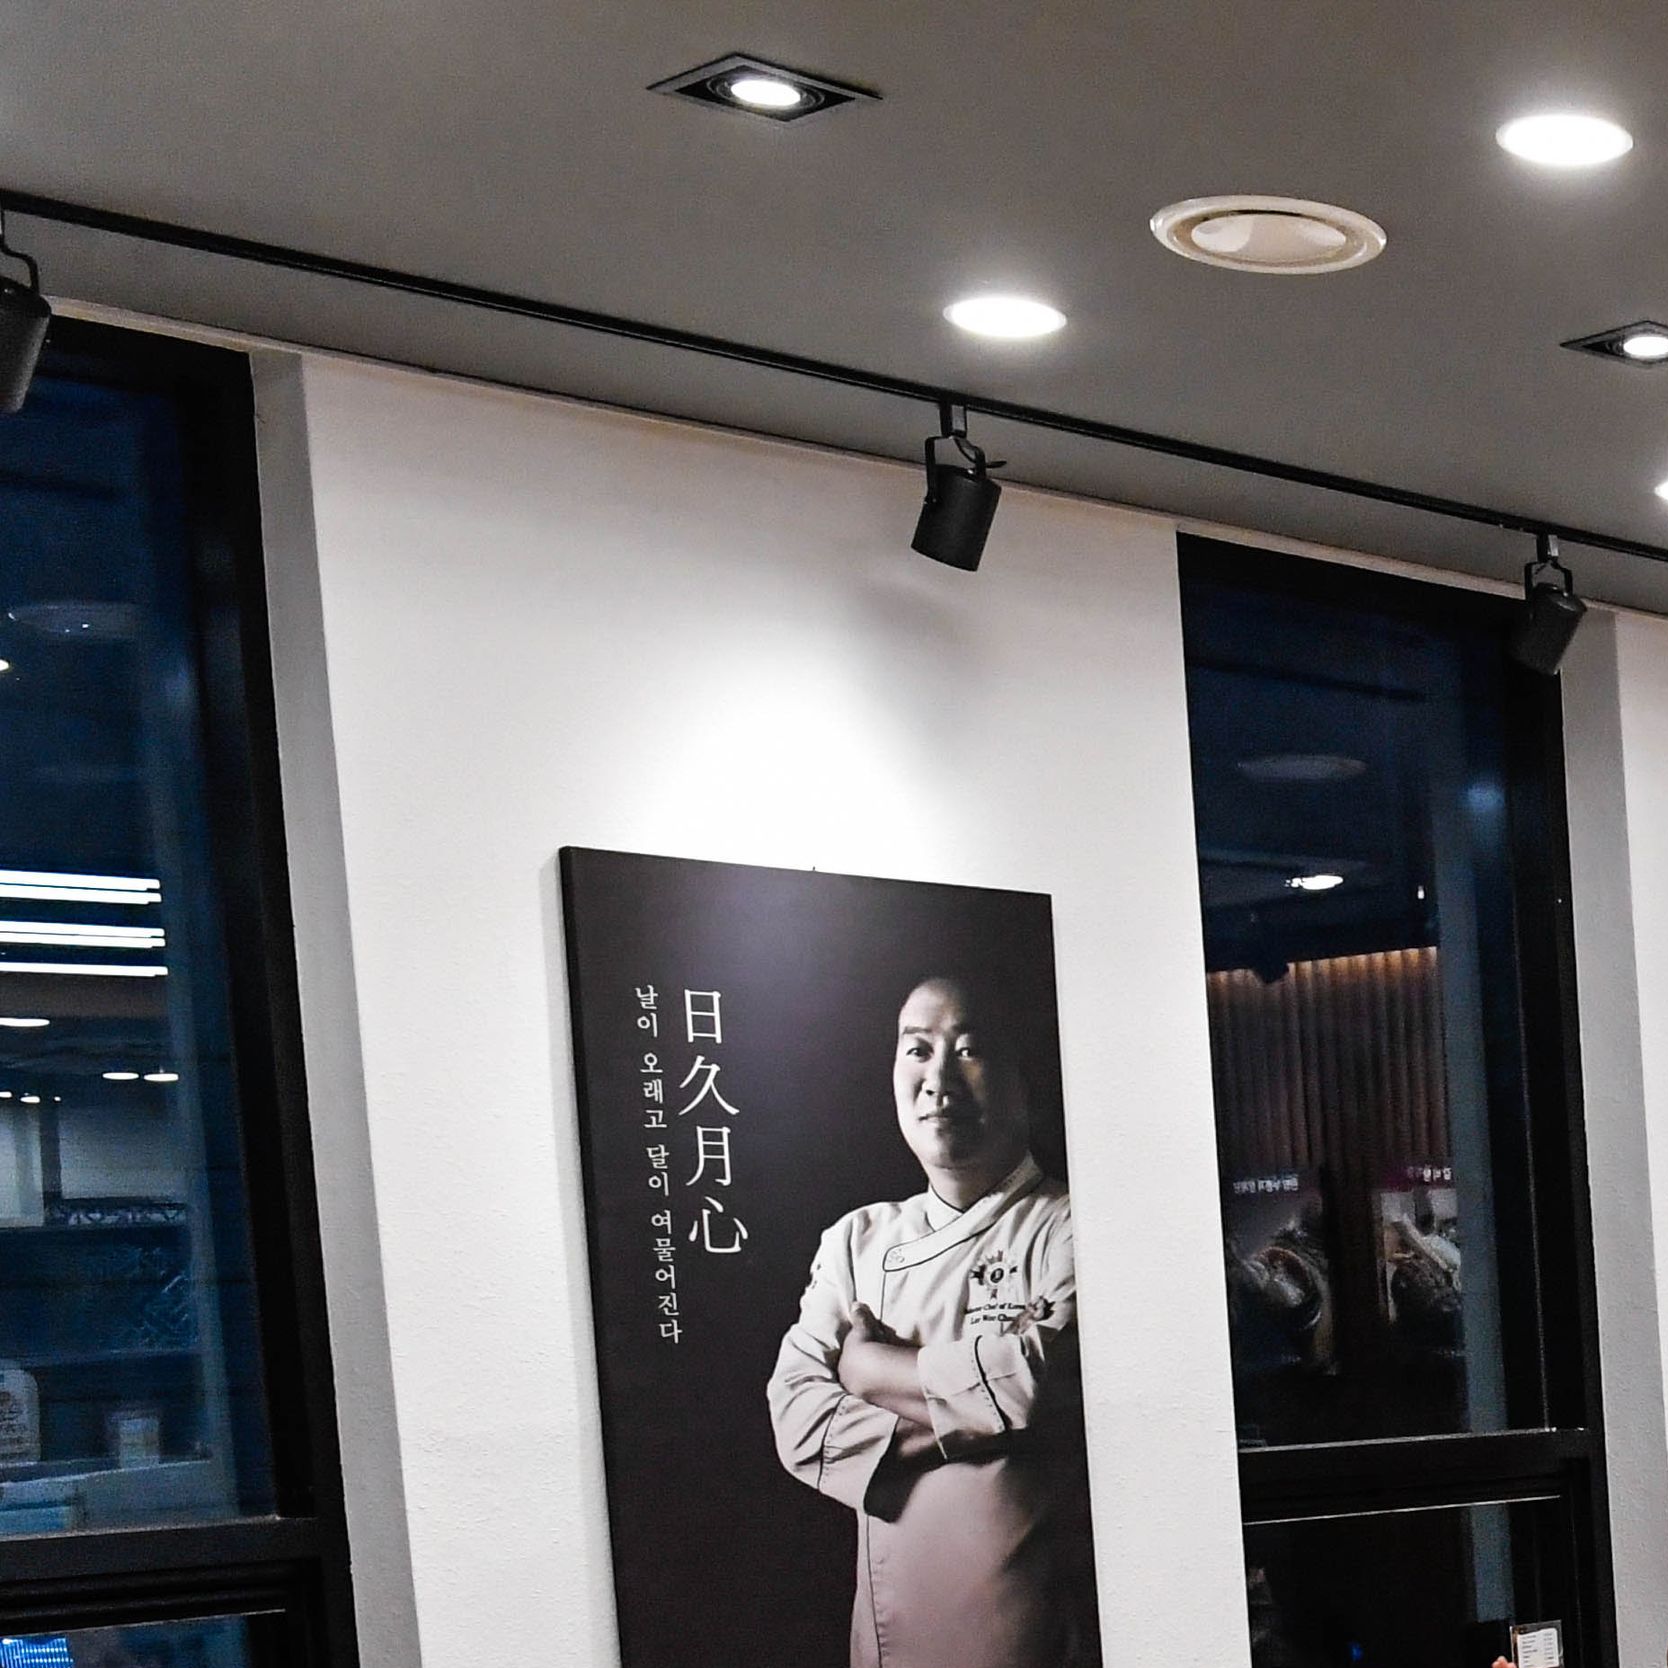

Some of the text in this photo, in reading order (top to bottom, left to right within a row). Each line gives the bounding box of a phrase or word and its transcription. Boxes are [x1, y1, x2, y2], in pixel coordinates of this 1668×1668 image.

[635, 984, 683, 1344] 날이 오래고 달이 여물어진다
[678, 989, 748, 1254] 日久月心
